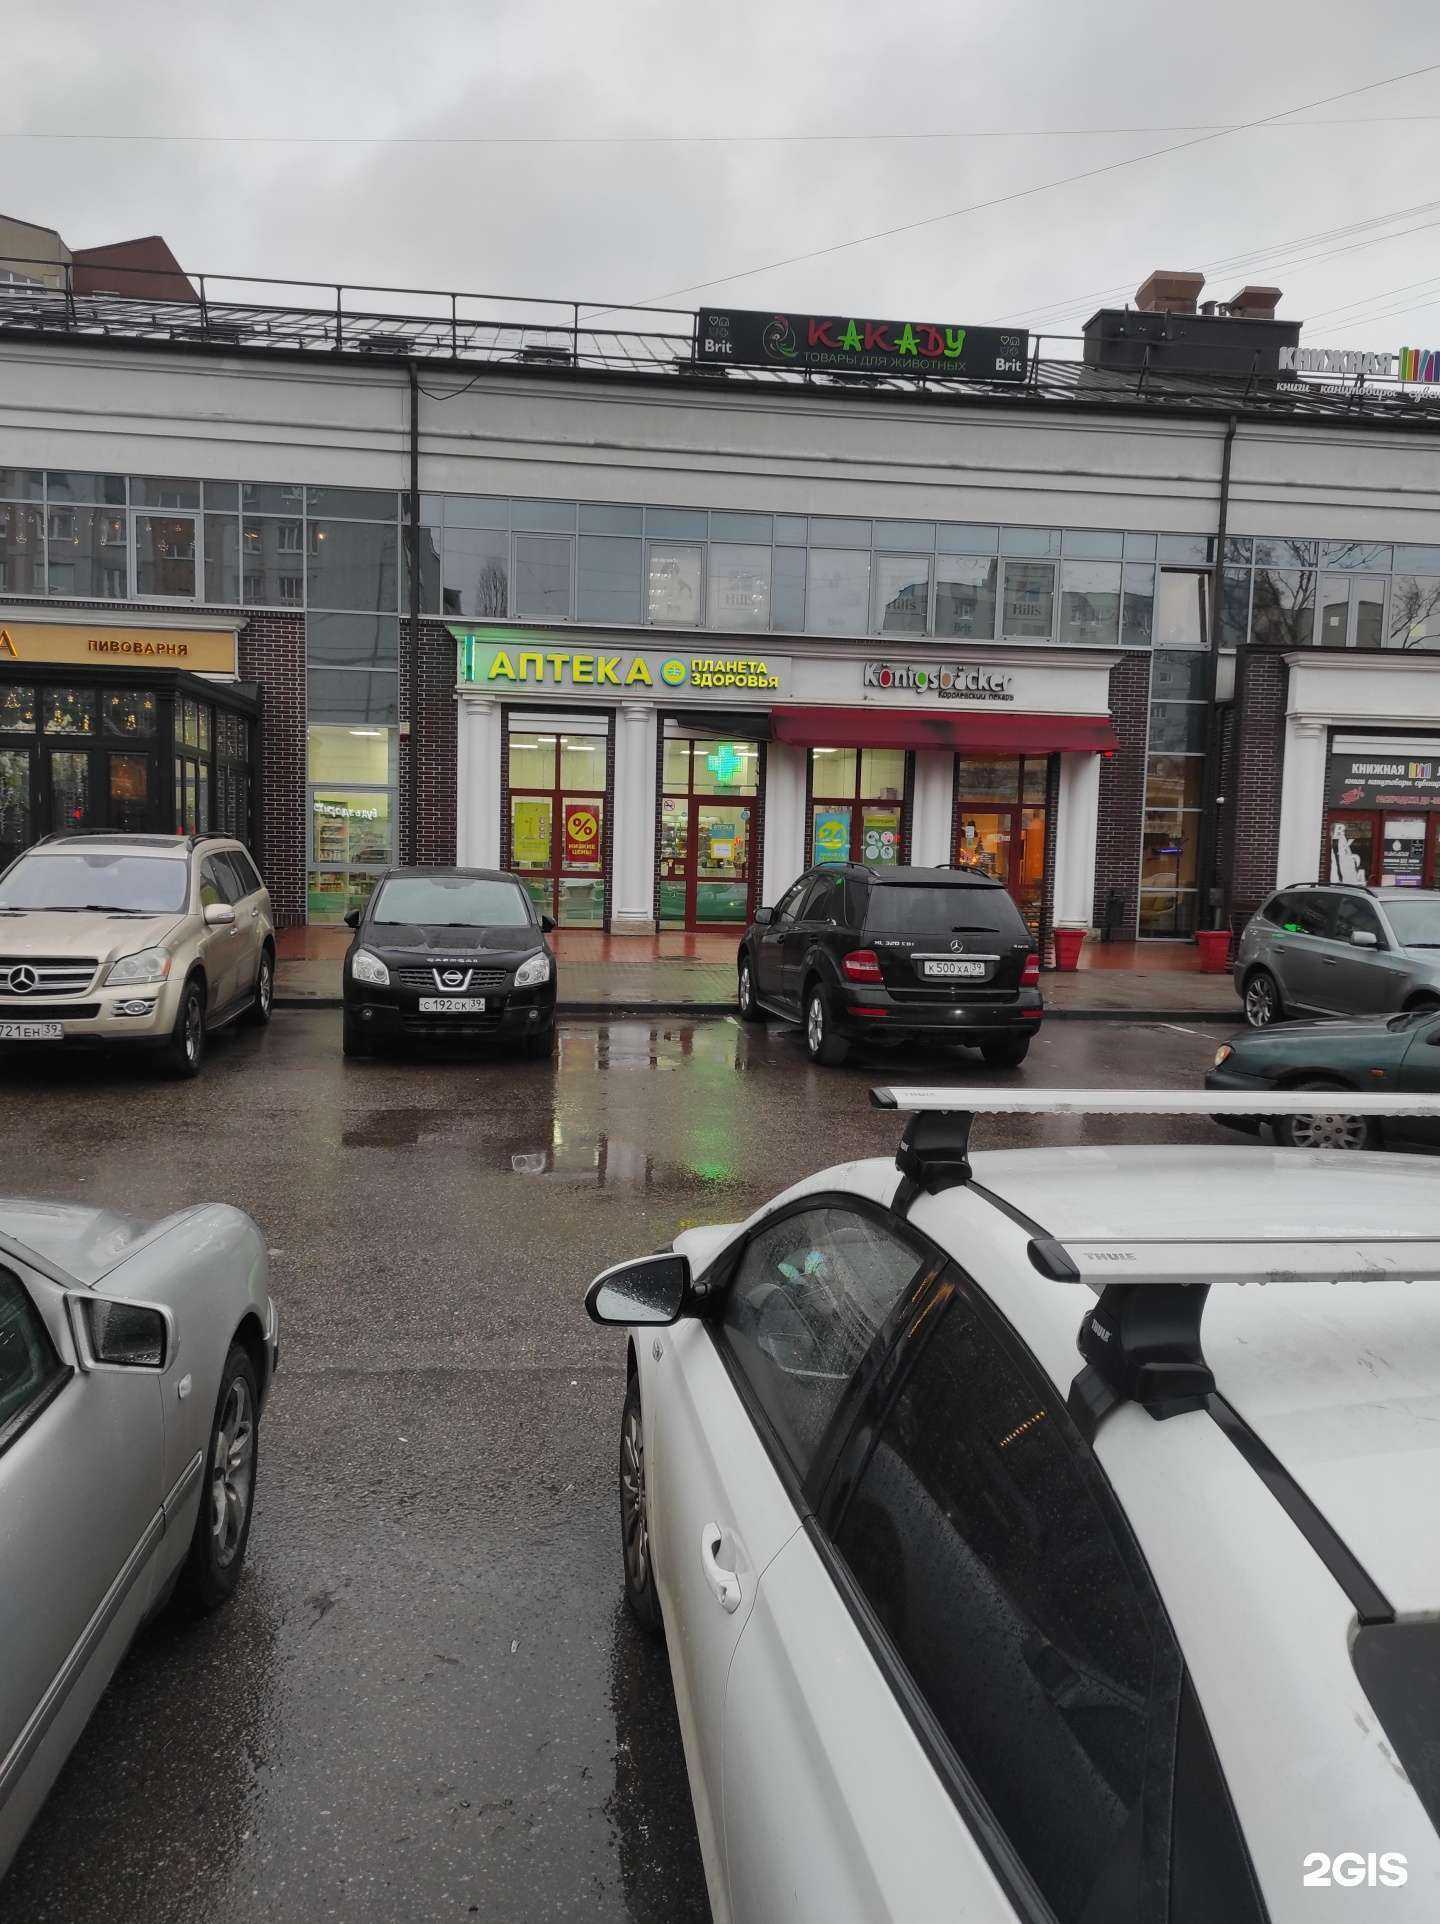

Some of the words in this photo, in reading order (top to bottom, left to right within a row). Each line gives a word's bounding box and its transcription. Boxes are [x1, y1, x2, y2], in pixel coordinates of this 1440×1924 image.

[705, 338, 733, 354] Brit
[804, 351, 857, 365] ТОВАРЫ
[860, 356, 888, 368] ДЛЯ
[890, 358, 966, 371] ЖИВОТНЫХ
[995, 358, 1023, 372] Brit
[1278, 346, 1393, 375] КНИЖНАЯ
[88, 640, 188, 656] ПИВОВАРНЯ
[487, 651, 652, 686] АПТЕКА
[691, 659, 768, 674] ПЛАНЕТА
[691, 673, 779, 688] ЗДОРОВЬЯ
[864, 662, 1014, 693] Königsbäcker
[1351, 763, 1406, 775] КНИЖНАЯ
